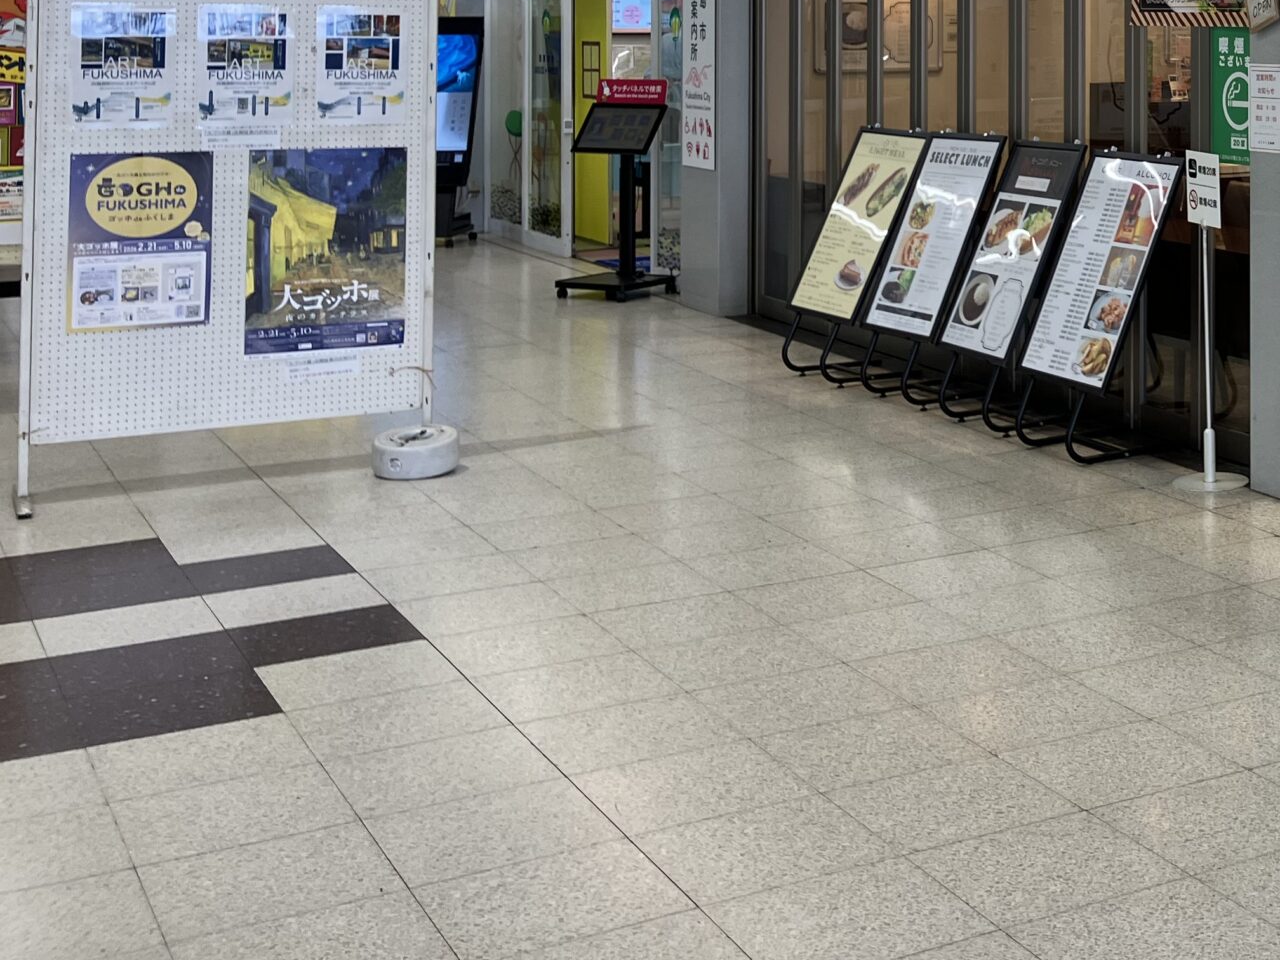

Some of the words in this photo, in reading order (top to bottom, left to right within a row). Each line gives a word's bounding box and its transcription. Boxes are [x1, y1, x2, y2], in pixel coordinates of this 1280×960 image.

[104, 56, 141, 70] ART
[230, 58, 262, 70] ART
[348, 58, 377, 70] ART
[82, 69, 163, 80] FUKUSHIMA
[208, 70, 284, 81] FUKUSHIMA
[326, 70, 398, 80] FUKUSHIMA
[929, 151, 959, 165] SELECT
[960, 153, 992, 168] LUNCH
[97, 198, 187, 211] FUKUSHIMA
